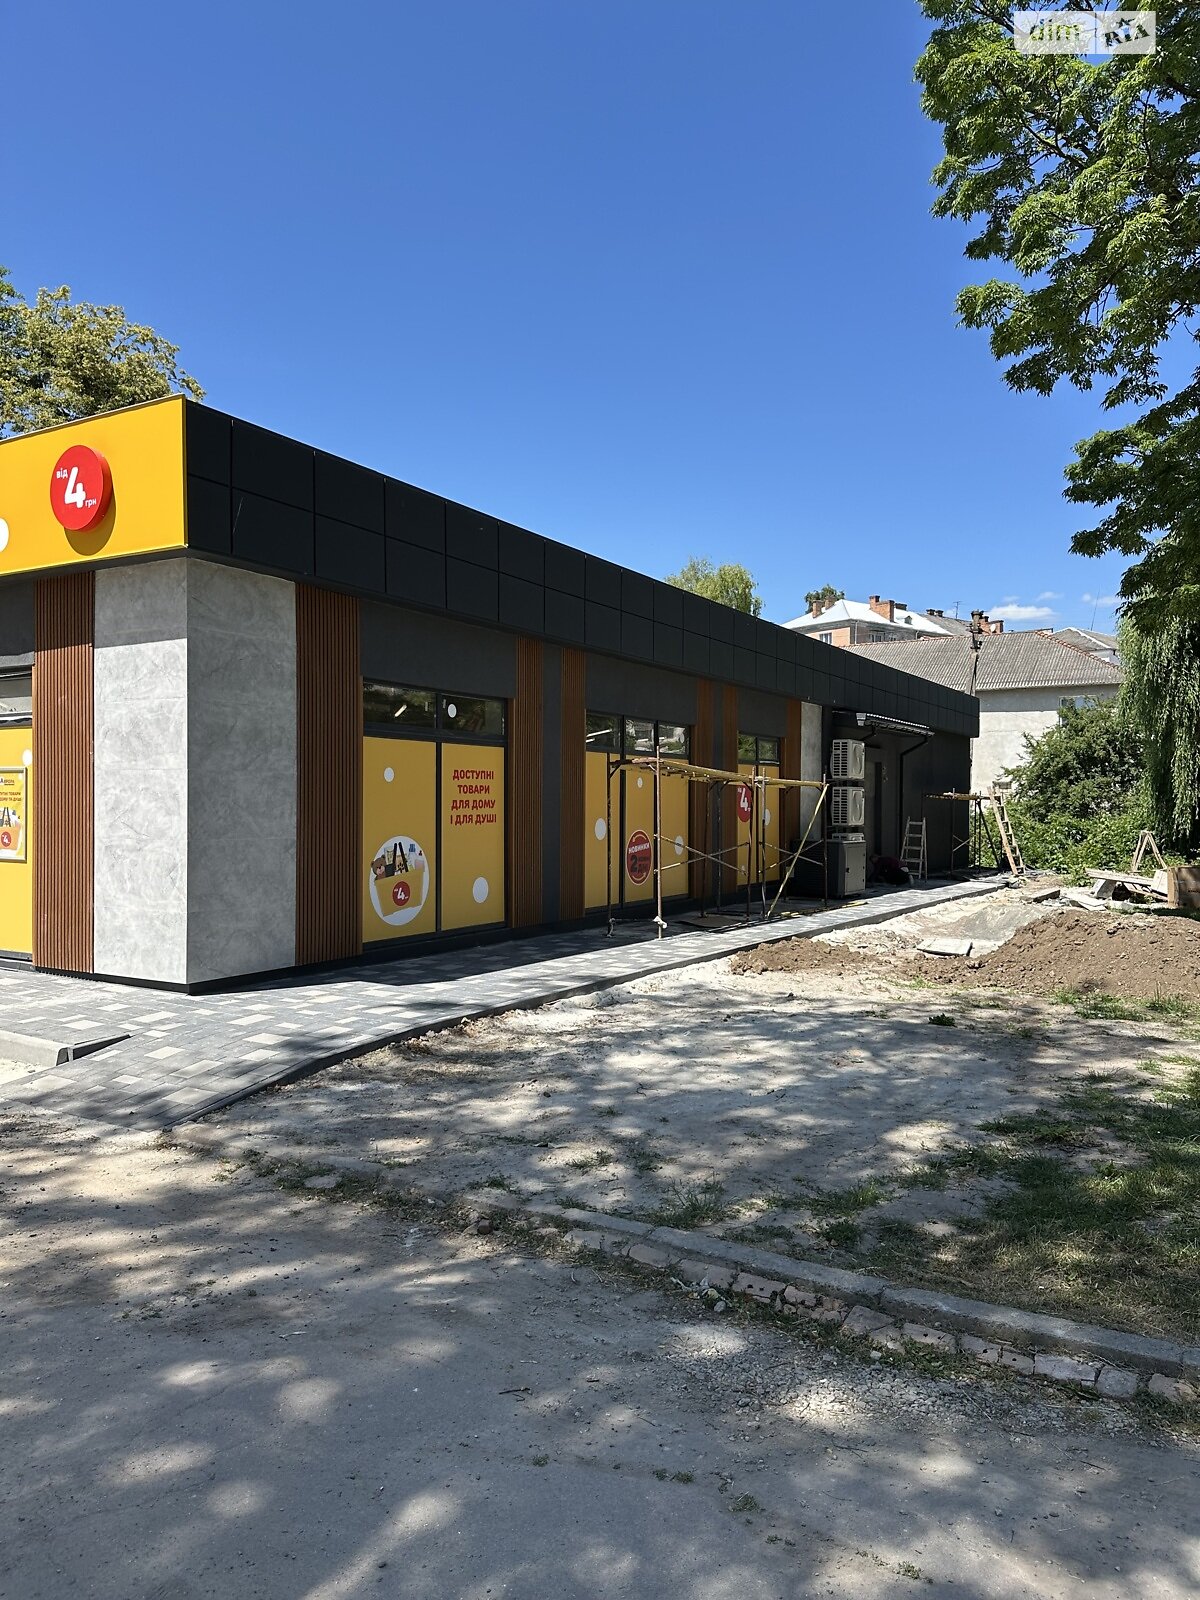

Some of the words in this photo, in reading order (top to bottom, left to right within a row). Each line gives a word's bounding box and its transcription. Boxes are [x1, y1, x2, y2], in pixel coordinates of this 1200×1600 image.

[56, 467, 69, 479] від
[64, 466, 86, 508] 4
[85, 498, 97, 509] грн
[453, 769, 494, 780] ДОСТУПНІ
[457, 785, 490, 794] ТОВАРИ
[451, 800, 470, 811] ДЛЯ
[472, 799, 496, 810] ДОМУ
[740, 788, 748, 811] 4
[455, 814, 473, 826] ДЛЯ
[475, 814, 497, 825] ДУШІ
[397, 887, 405, 900] 4
